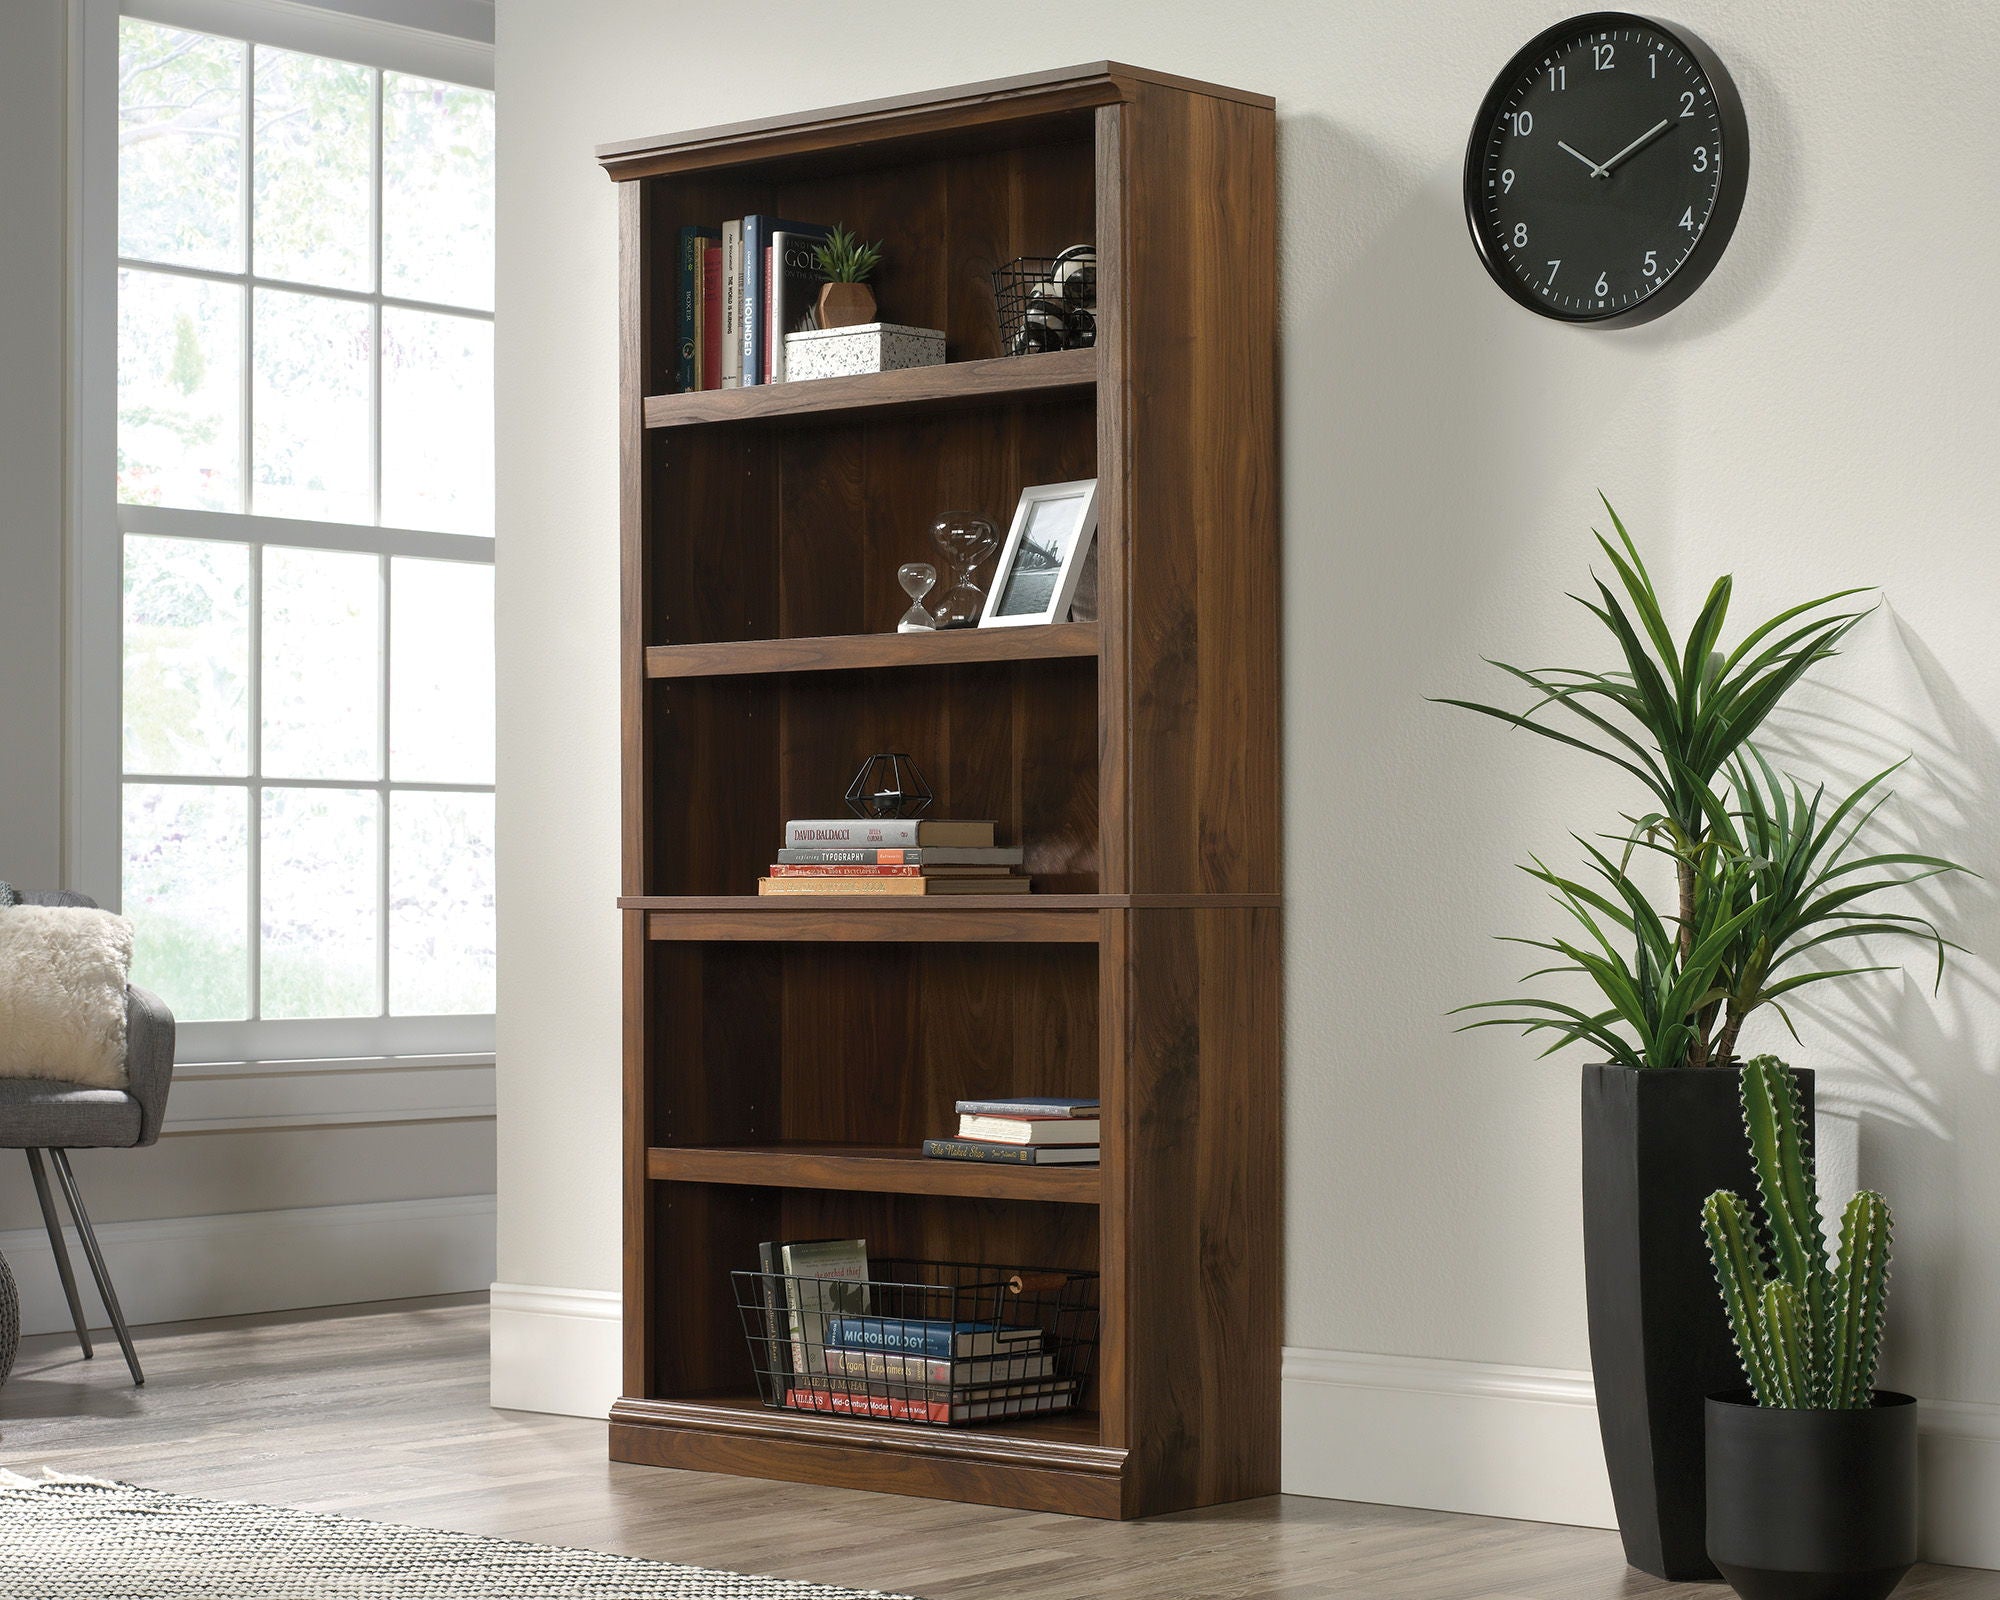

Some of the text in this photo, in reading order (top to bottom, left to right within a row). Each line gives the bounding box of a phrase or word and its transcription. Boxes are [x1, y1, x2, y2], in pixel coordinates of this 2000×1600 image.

[1592, 44, 1615, 71] 12
[1648, 54, 1656, 79] 1
[1548, 66, 1566, 91] 11
[1679, 92, 1695, 118] 2
[1510, 111, 1533, 137] 10
[1692, 146, 1708, 172] 3
[1501, 169, 1515, 194] 9
[1678, 206, 1694, 231] 4
[1513, 222, 1528, 248] 8
[1547, 260, 1561, 285] 7
[1642, 251, 1657, 276] 5
[1594, 271, 1609, 297] 6
[744, 298, 752, 356] HOUNDED
[794, 829, 849, 841] DAVID BALDACCI
[822, 852, 864, 861] TYPOGRAPHY
[846, 1265, 862, 1276] thief
[844, 1330, 924, 1348] MICROBIOLOGY
[839, 1354, 865, 1374] Organi
[870, 1357, 912, 1377] Expriments
[822, 1378, 836, 1390] TJ
[832, 1398, 868, 1410] Mid-Cntury
